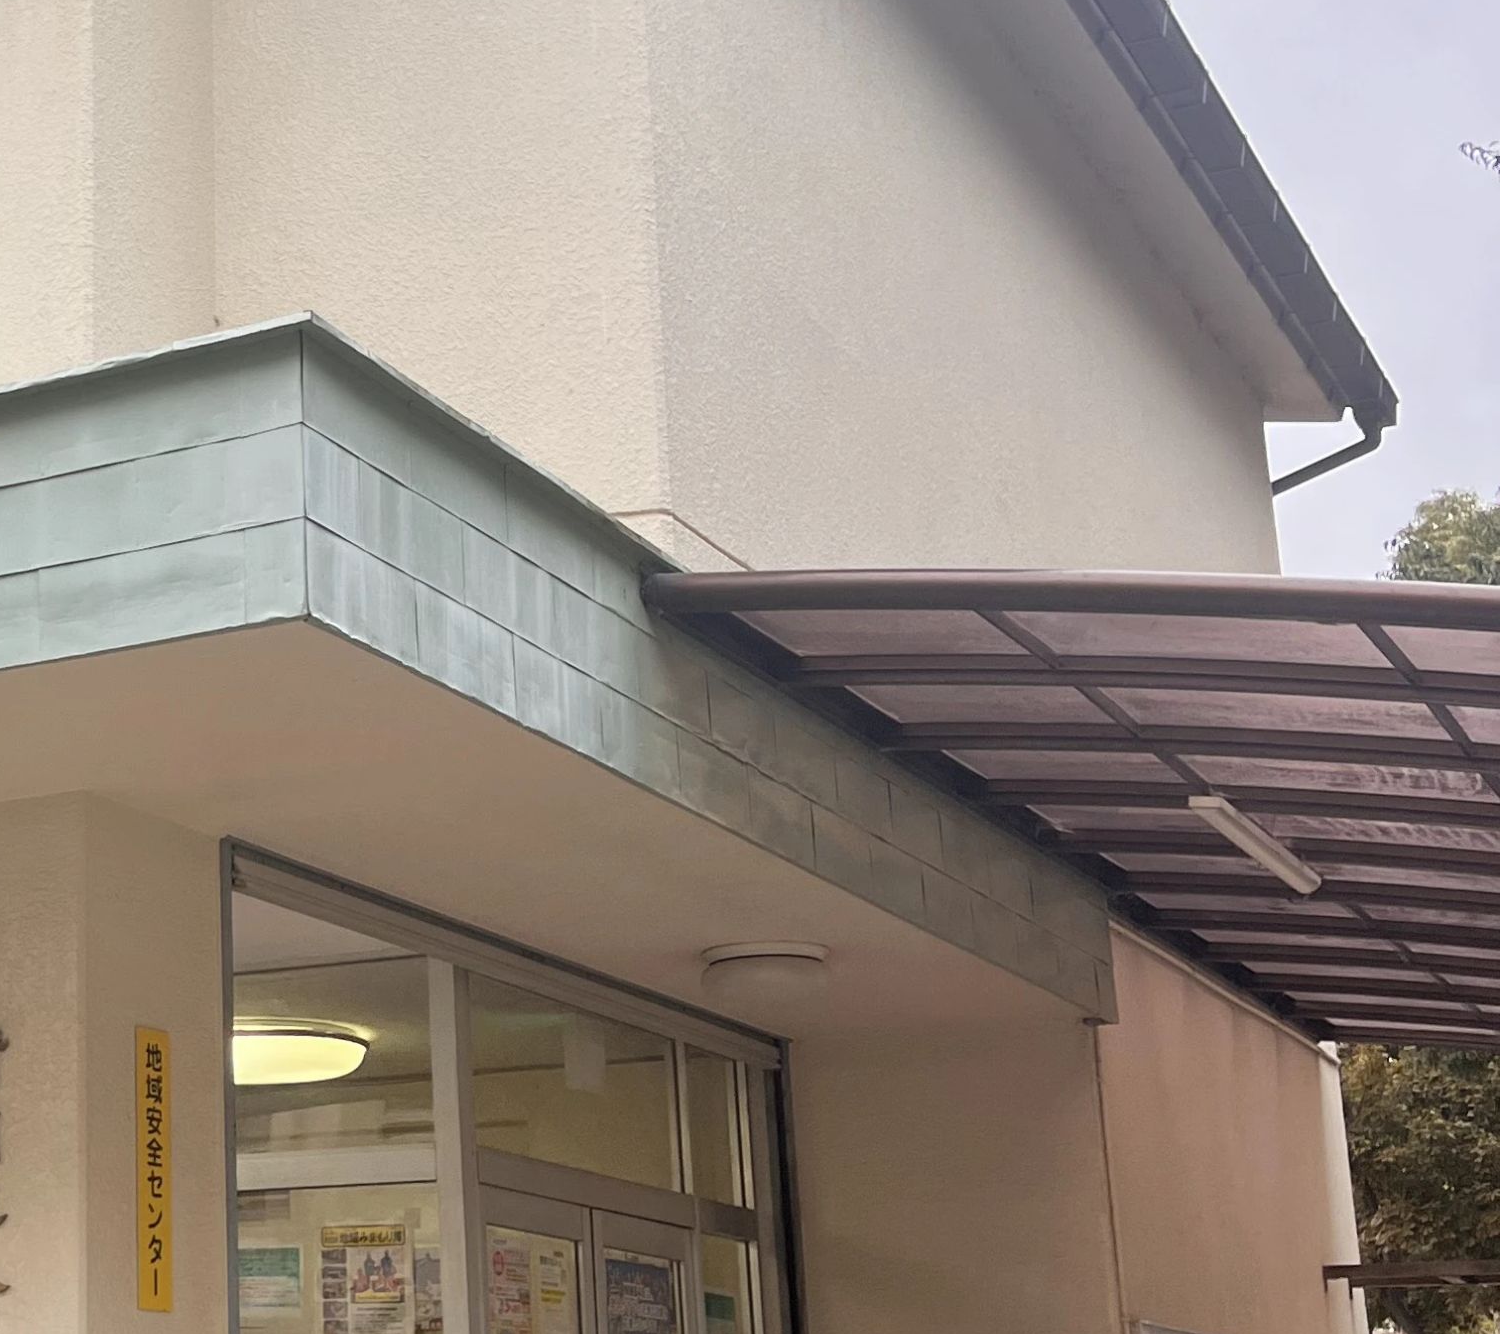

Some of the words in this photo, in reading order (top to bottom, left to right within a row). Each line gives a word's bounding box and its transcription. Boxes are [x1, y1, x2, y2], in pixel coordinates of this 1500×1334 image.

[145, 1043, 164, 1297] 地域安全センター
